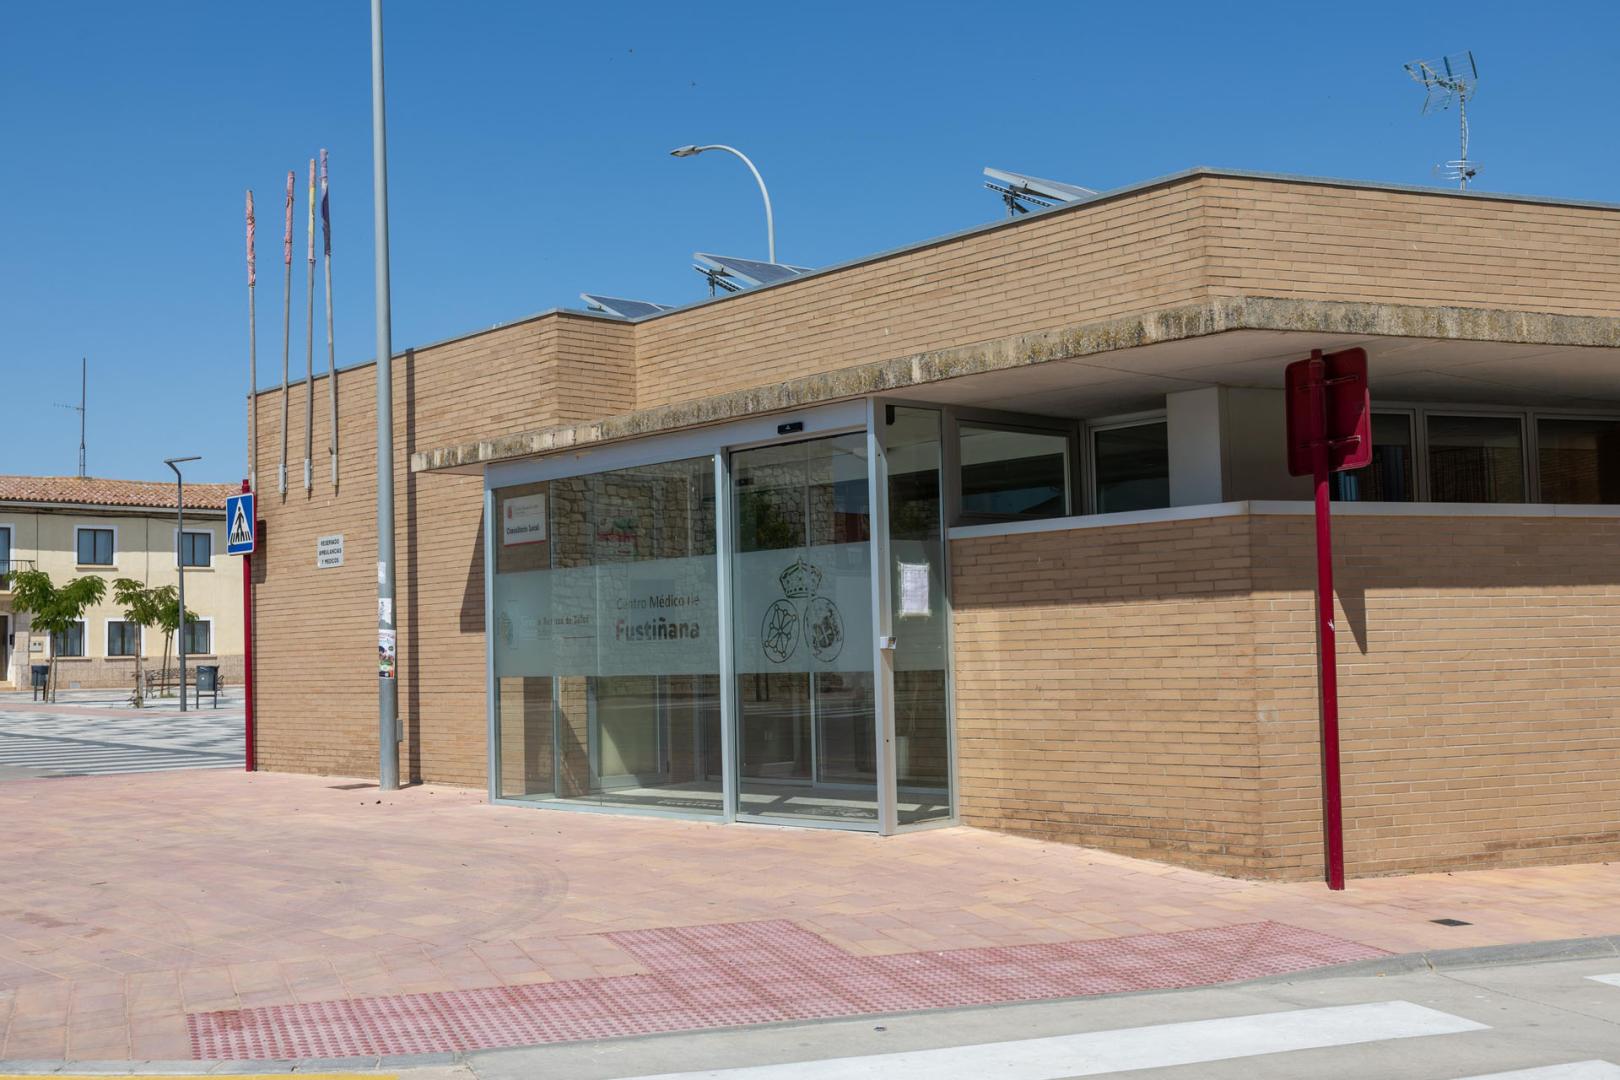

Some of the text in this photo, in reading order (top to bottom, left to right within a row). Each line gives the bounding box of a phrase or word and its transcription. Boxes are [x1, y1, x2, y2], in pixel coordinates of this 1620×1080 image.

[616, 598, 646, 610] Centro
[650, 594, 684, 608] Médico
[616, 617, 700, 640] Fustiñana
